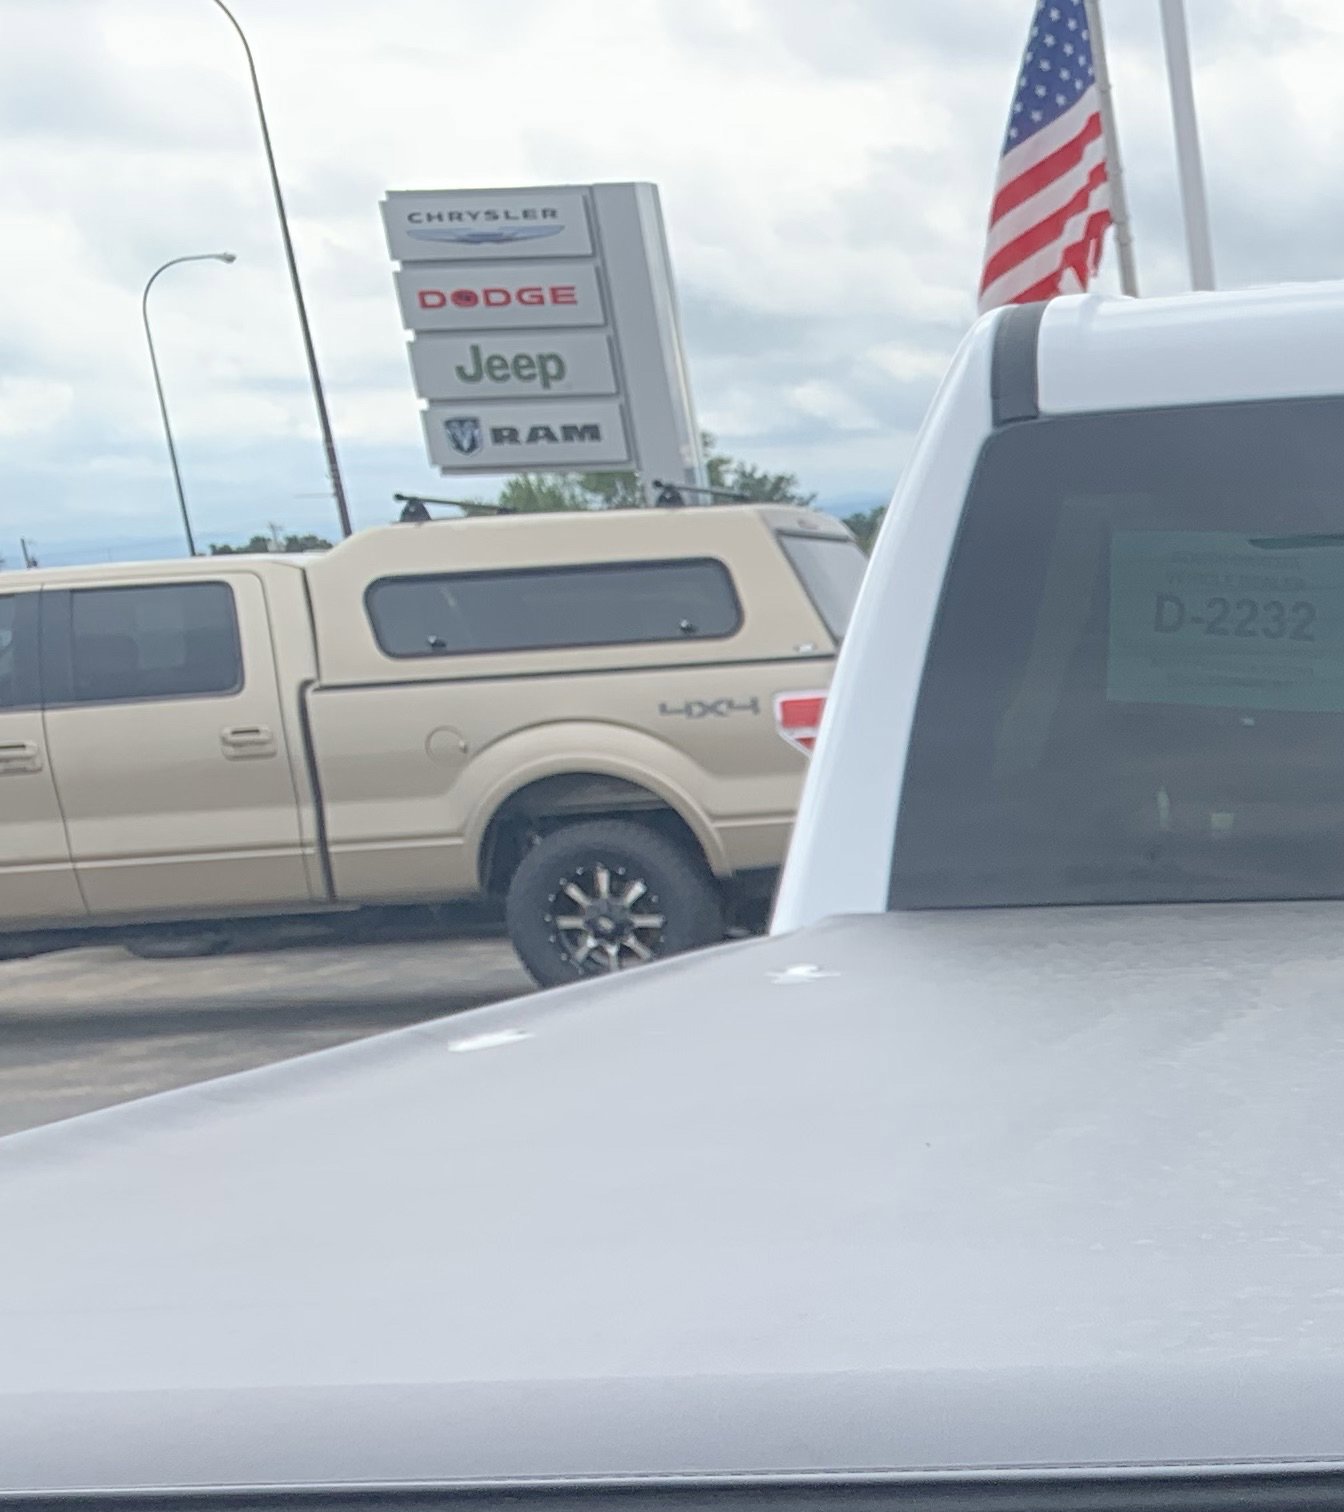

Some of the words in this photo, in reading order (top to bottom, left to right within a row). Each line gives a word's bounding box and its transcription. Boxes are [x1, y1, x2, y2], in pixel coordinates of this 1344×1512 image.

[407, 208, 558, 224] CHRYSLER
[418, 287, 578, 309] DODGE
[455, 344, 566, 389] Jeep
[490, 424, 602, 445] RAM
[1154, 593, 1317, 641] D-2232
